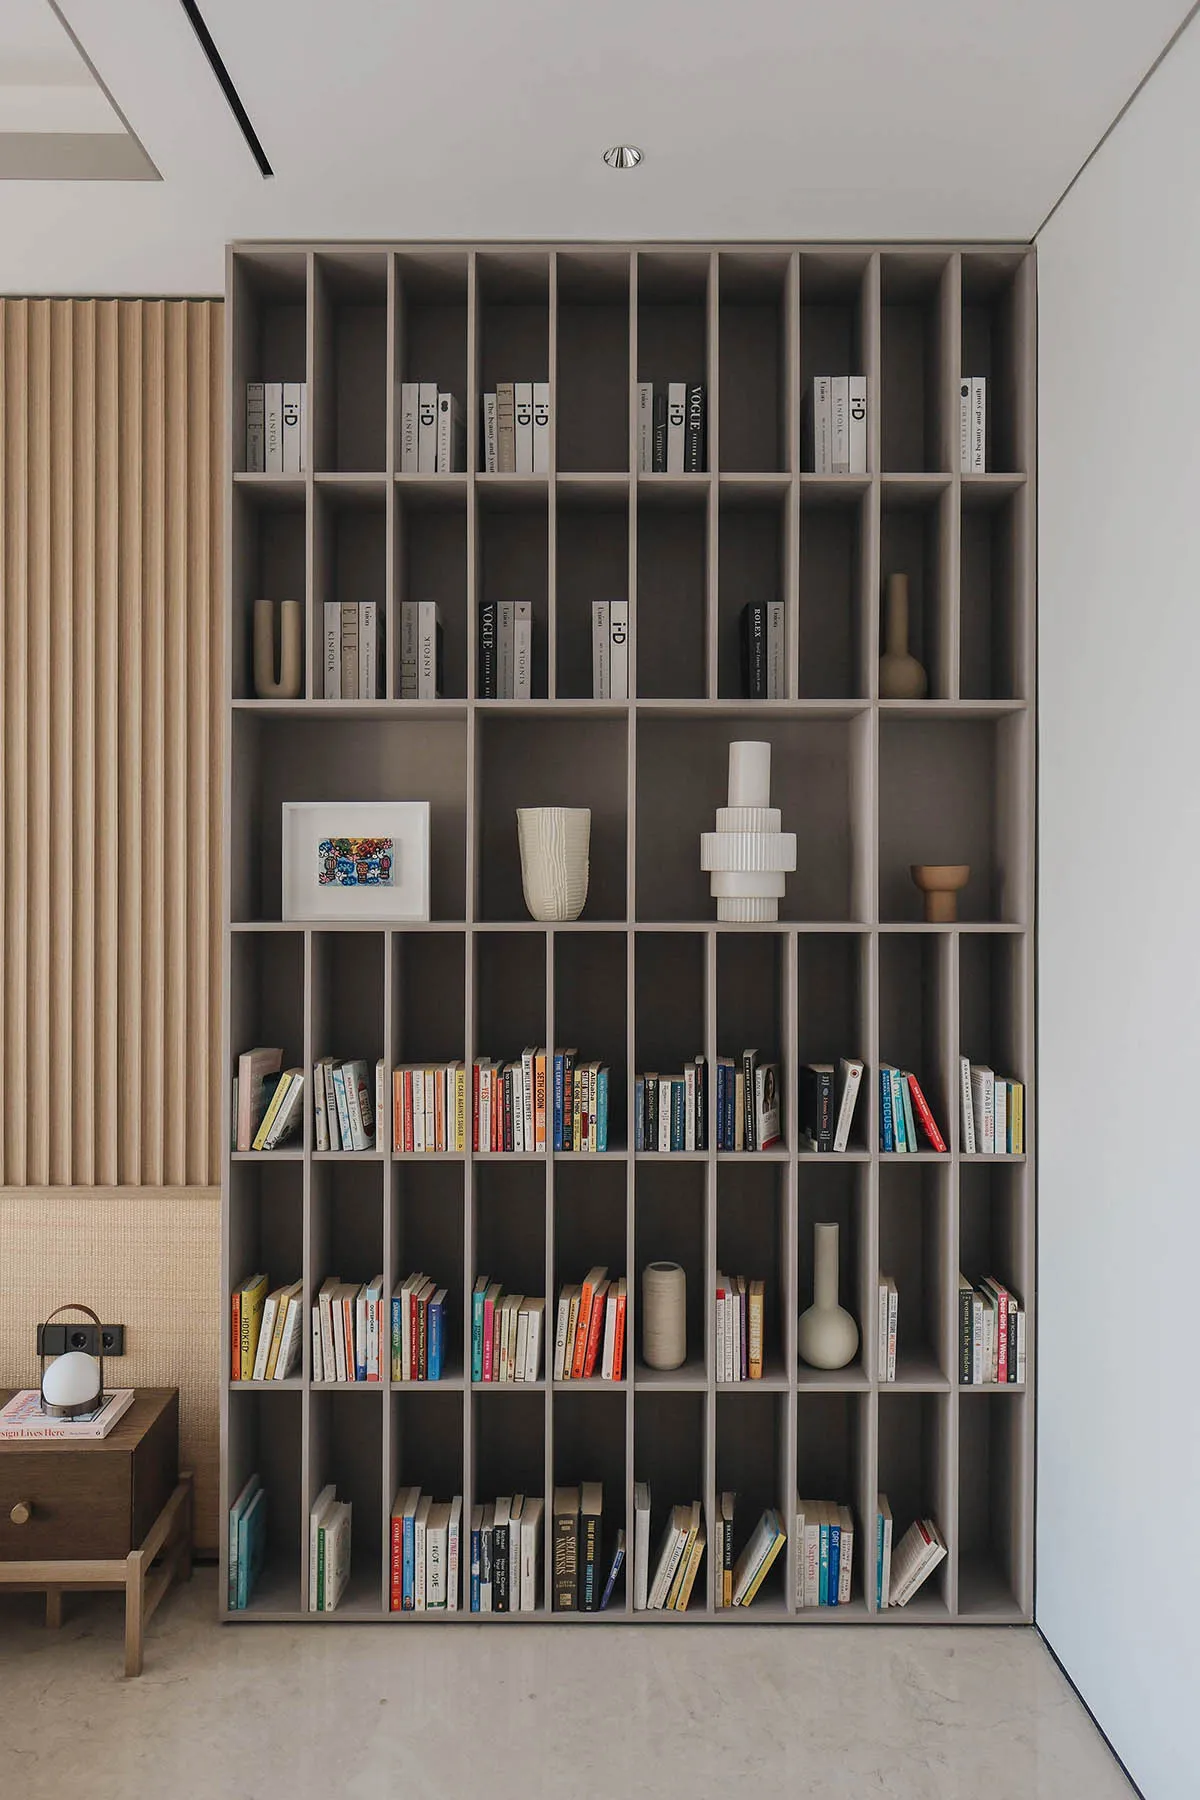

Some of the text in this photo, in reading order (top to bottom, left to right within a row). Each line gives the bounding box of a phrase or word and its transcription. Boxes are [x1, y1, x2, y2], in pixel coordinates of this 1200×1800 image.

[284, 404, 298, 426] i-D
[421, 404, 434, 426] i-D
[518, 404, 530, 426] i-D
[536, 404, 548, 426] i-D
[670, 404, 684, 426] i-D
[690, 386, 702, 430] VOGUE
[852, 398, 866, 420] i-D
[343, 608, 356, 652] ELLE
[482, 604, 494, 649] VOGUE
[612, 622, 626, 644] i-D
[883, 1096, 892, 1130] FOCUS
[0, 1428, 64, 1438] sign Lives Here
[556, 1538, 565, 1575] ANALYSIS
[566, 1536, 576, 1574] SECURITY
[820, 1530, 828, 1558] mindset
[668, 1546, 682, 1579] Educated
[808, 1543, 816, 1580] Sapiens
